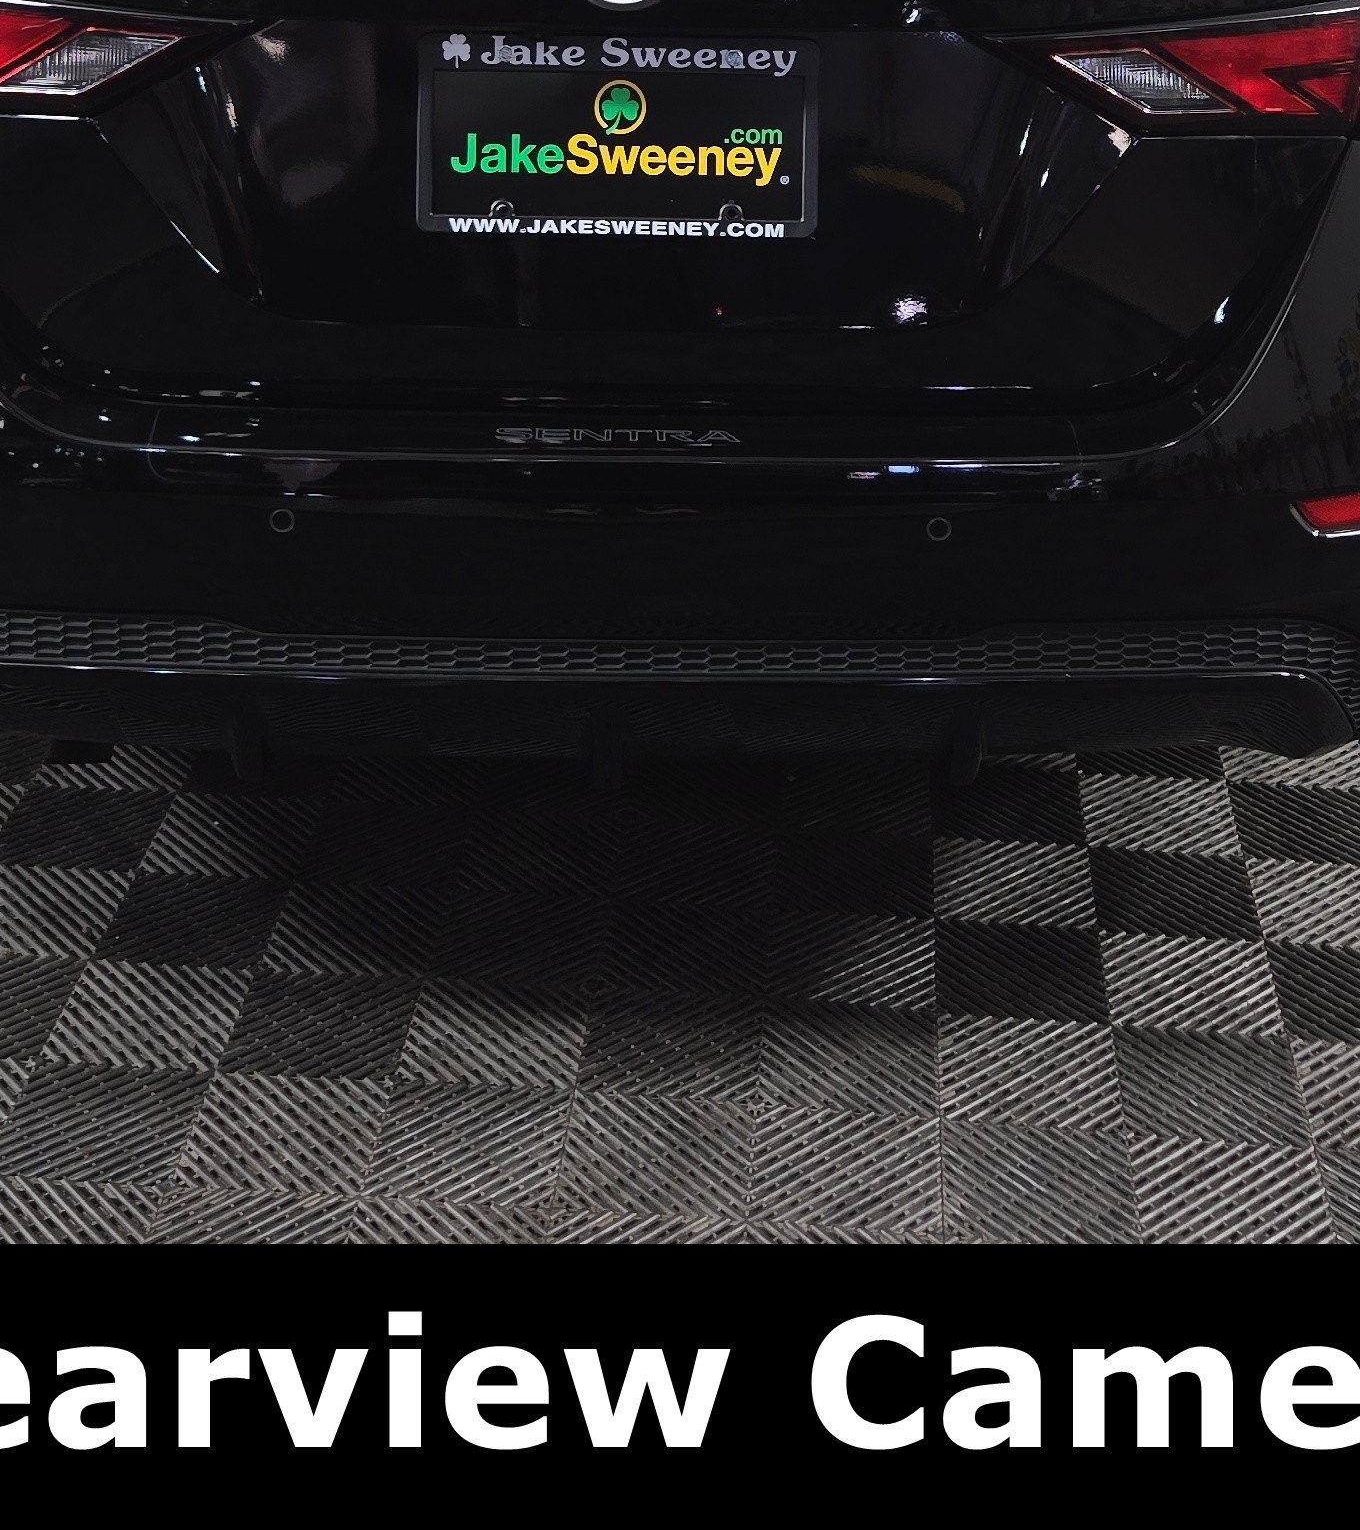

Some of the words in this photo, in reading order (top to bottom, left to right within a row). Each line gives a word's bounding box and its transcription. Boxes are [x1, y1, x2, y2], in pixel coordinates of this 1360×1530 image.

[480, 35, 586, 67] Jake
[600, 37, 797, 77] Sweeney
[449, 217, 785, 238] WWW.JAKESWEENEY.COM
[495, 427, 740, 444] SENTRA
